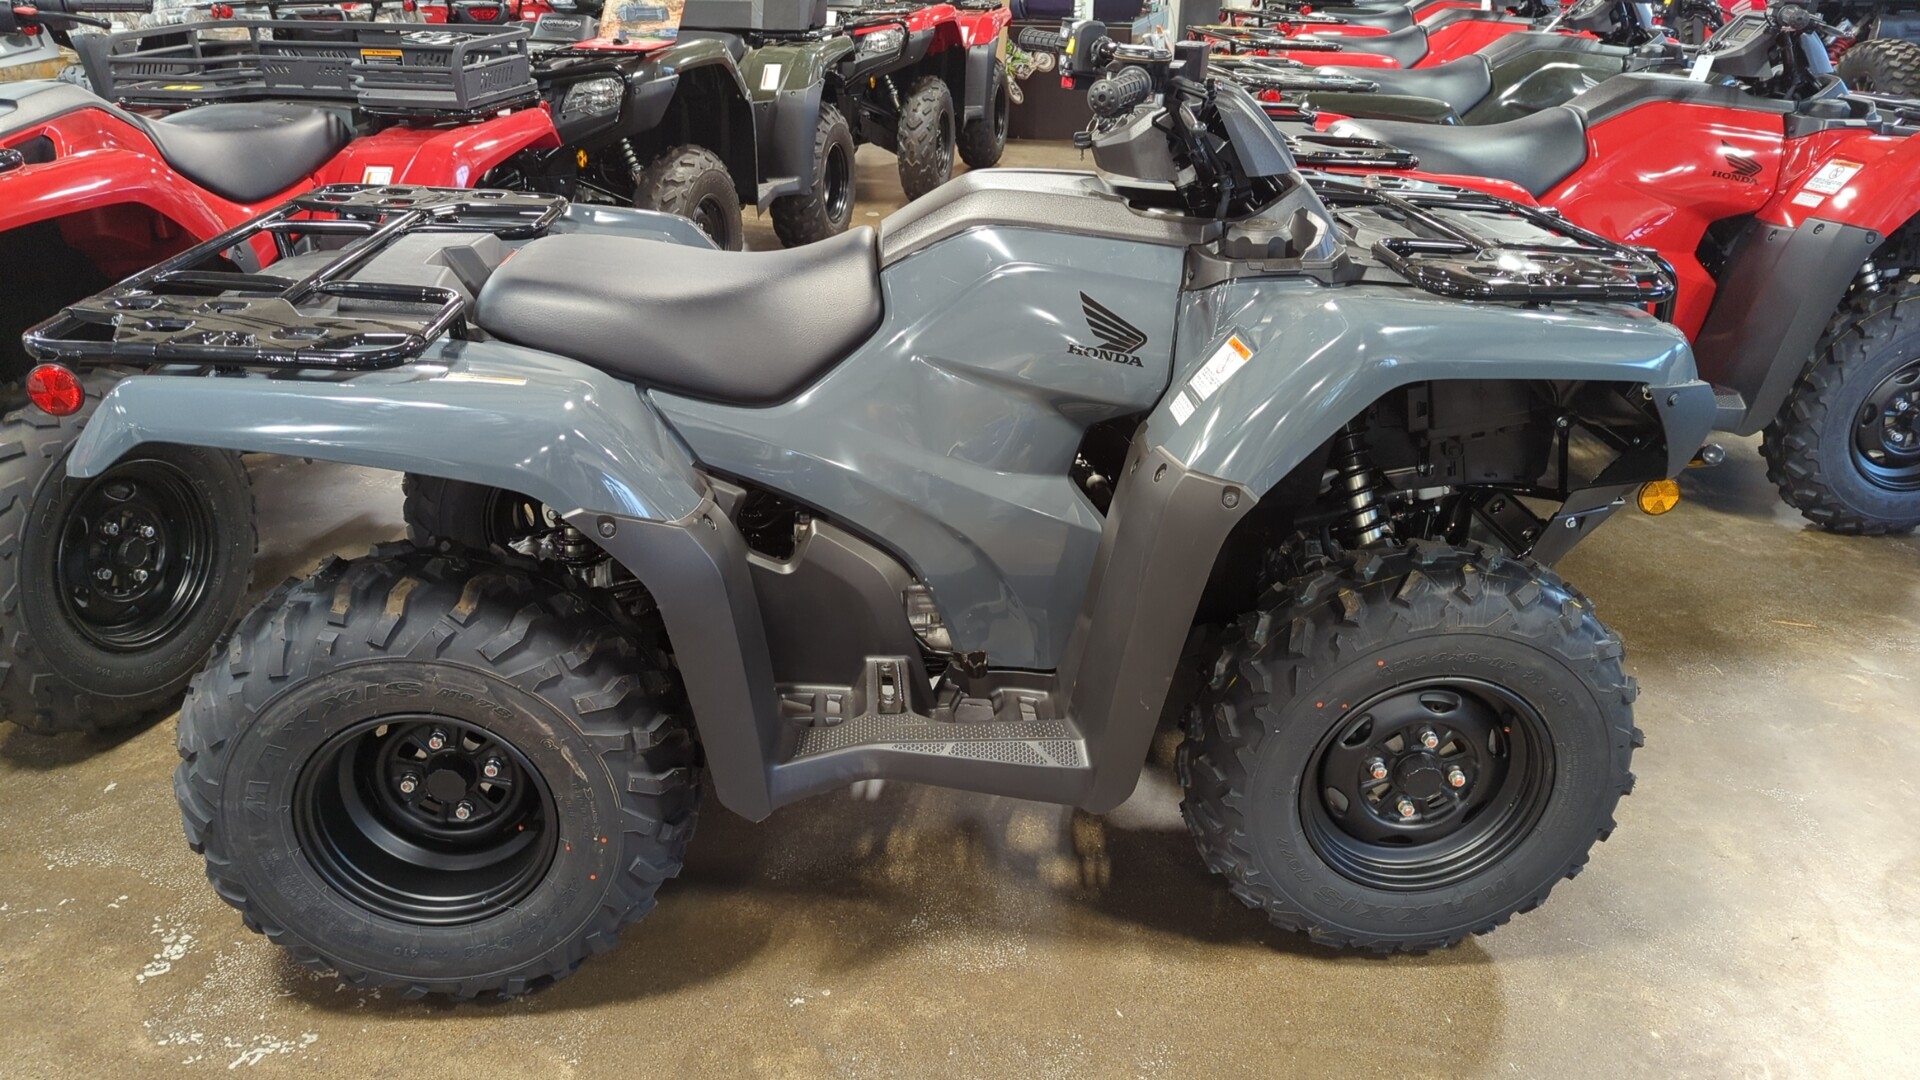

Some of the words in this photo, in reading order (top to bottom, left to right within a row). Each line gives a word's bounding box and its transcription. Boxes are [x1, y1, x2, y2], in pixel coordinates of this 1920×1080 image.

[1712, 170, 1759, 185] HONDA
[1067, 343, 1144, 368] HONDA
[243, 681, 424, 822] MAXXIS
[1313, 869, 1520, 923] MAXXIS
